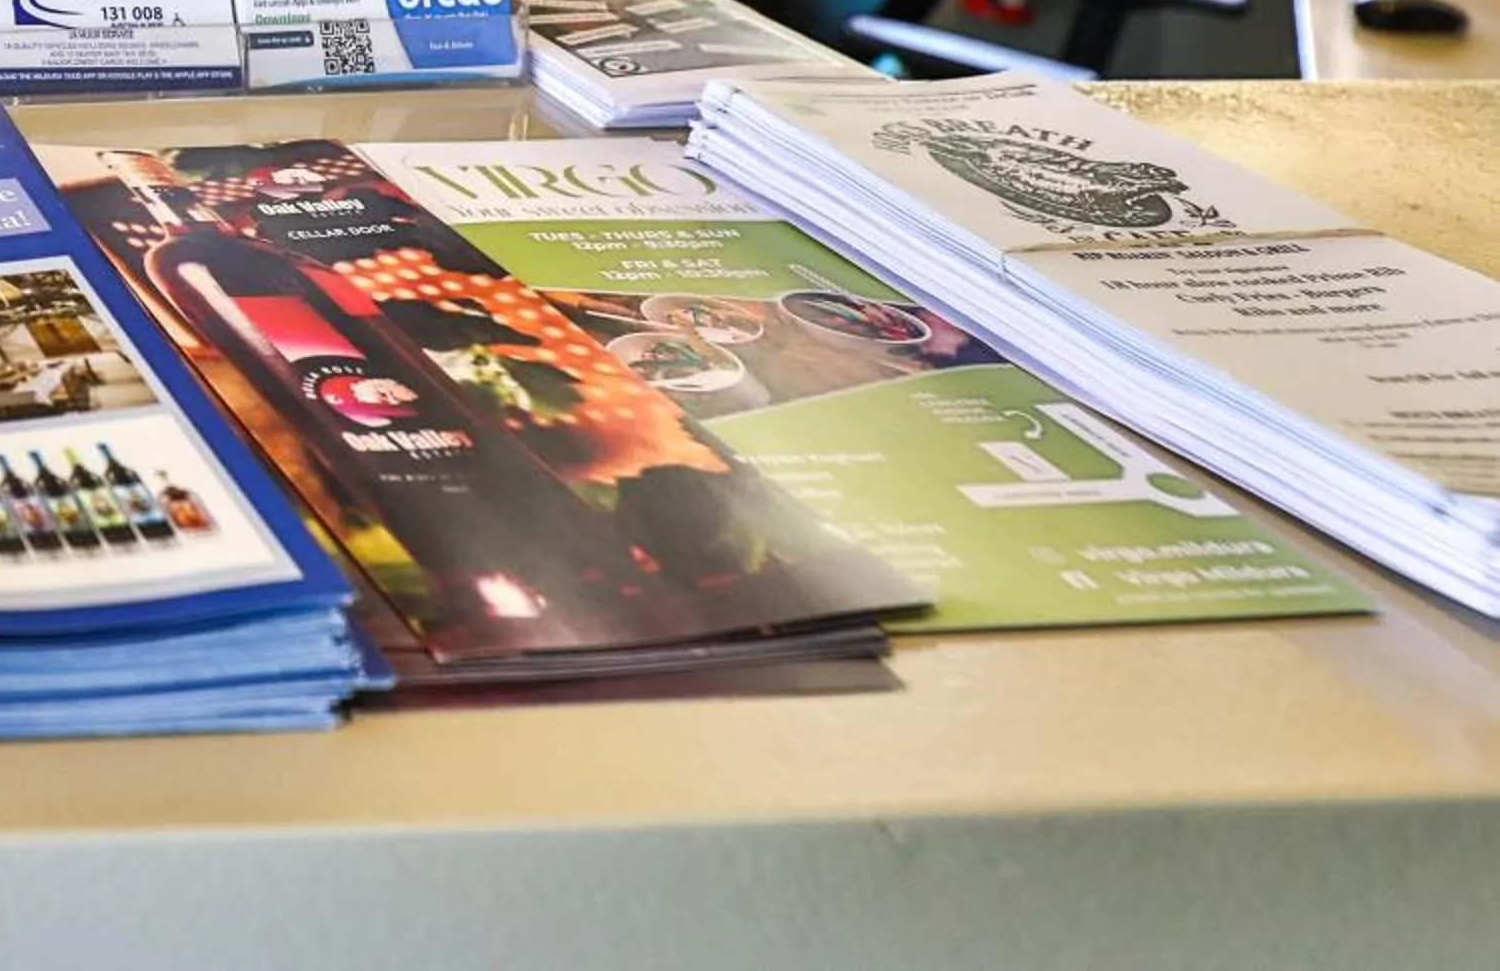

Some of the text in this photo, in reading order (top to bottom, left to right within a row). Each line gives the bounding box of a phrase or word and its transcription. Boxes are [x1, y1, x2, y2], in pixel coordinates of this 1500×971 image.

[100, 6, 163, 21] 131 008
[405, 163, 718, 200] VIRGO
[257, 198, 365, 216] Oak Valley
[449, 204, 512, 221] Your
[287, 223, 396, 240] CELLAR DOOR
[529, 231, 585, 243] TUES
[601, 230, 673, 241] THURS
[677, 230, 693, 239] &
[696, 229, 741, 239] SUN
[572, 240, 629, 252] 12pm
[620, 258, 723, 270] FRI & SAT
[601, 269, 662, 281] 12pm
[1127, 279, 1179, 289] hour
[1184, 278, 1228, 288] slow
[1232, 276, 1307, 287] cooked
[1302, 271, 1366, 283] Prime
[1174, 293, 1235, 305] Curly
[1233, 291, 1289, 302] Fries
[1299, 286, 1388, 298] Burgers
[1288, 304, 1328, 315] and
[1327, 304, 1382, 314] more
[386, 428, 475, 451] Valley
